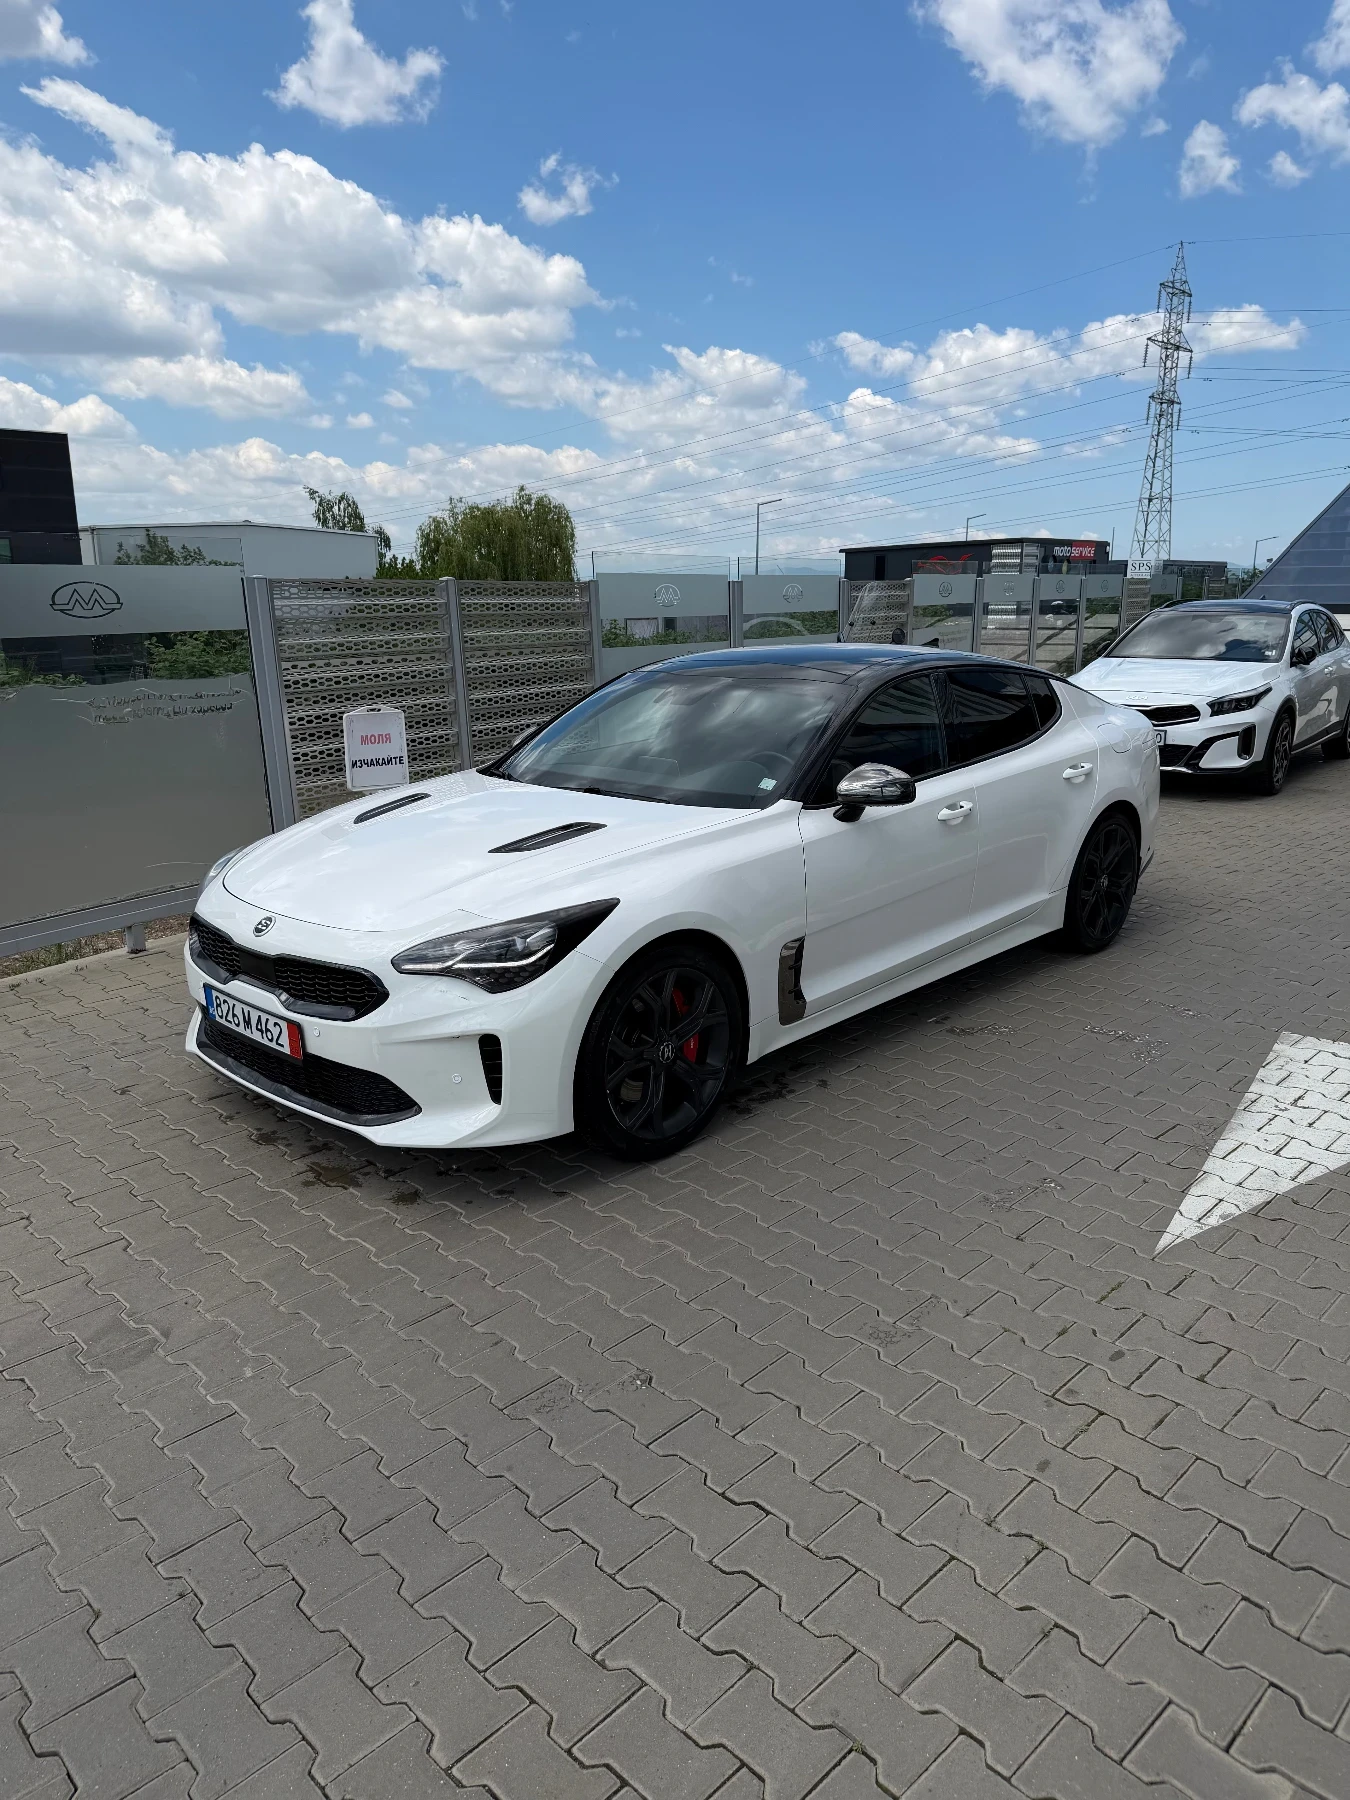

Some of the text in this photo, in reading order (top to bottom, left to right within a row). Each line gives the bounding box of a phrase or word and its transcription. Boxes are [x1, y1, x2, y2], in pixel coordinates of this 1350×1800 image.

[1130, 561, 1152, 571] SPS
[360, 733, 392, 746] МОЛЯ
[351, 754, 405, 769] ИЗЧАКАЙТЕ
[214, 995, 241, 1028] 826
[255, 1014, 285, 1049] 462
